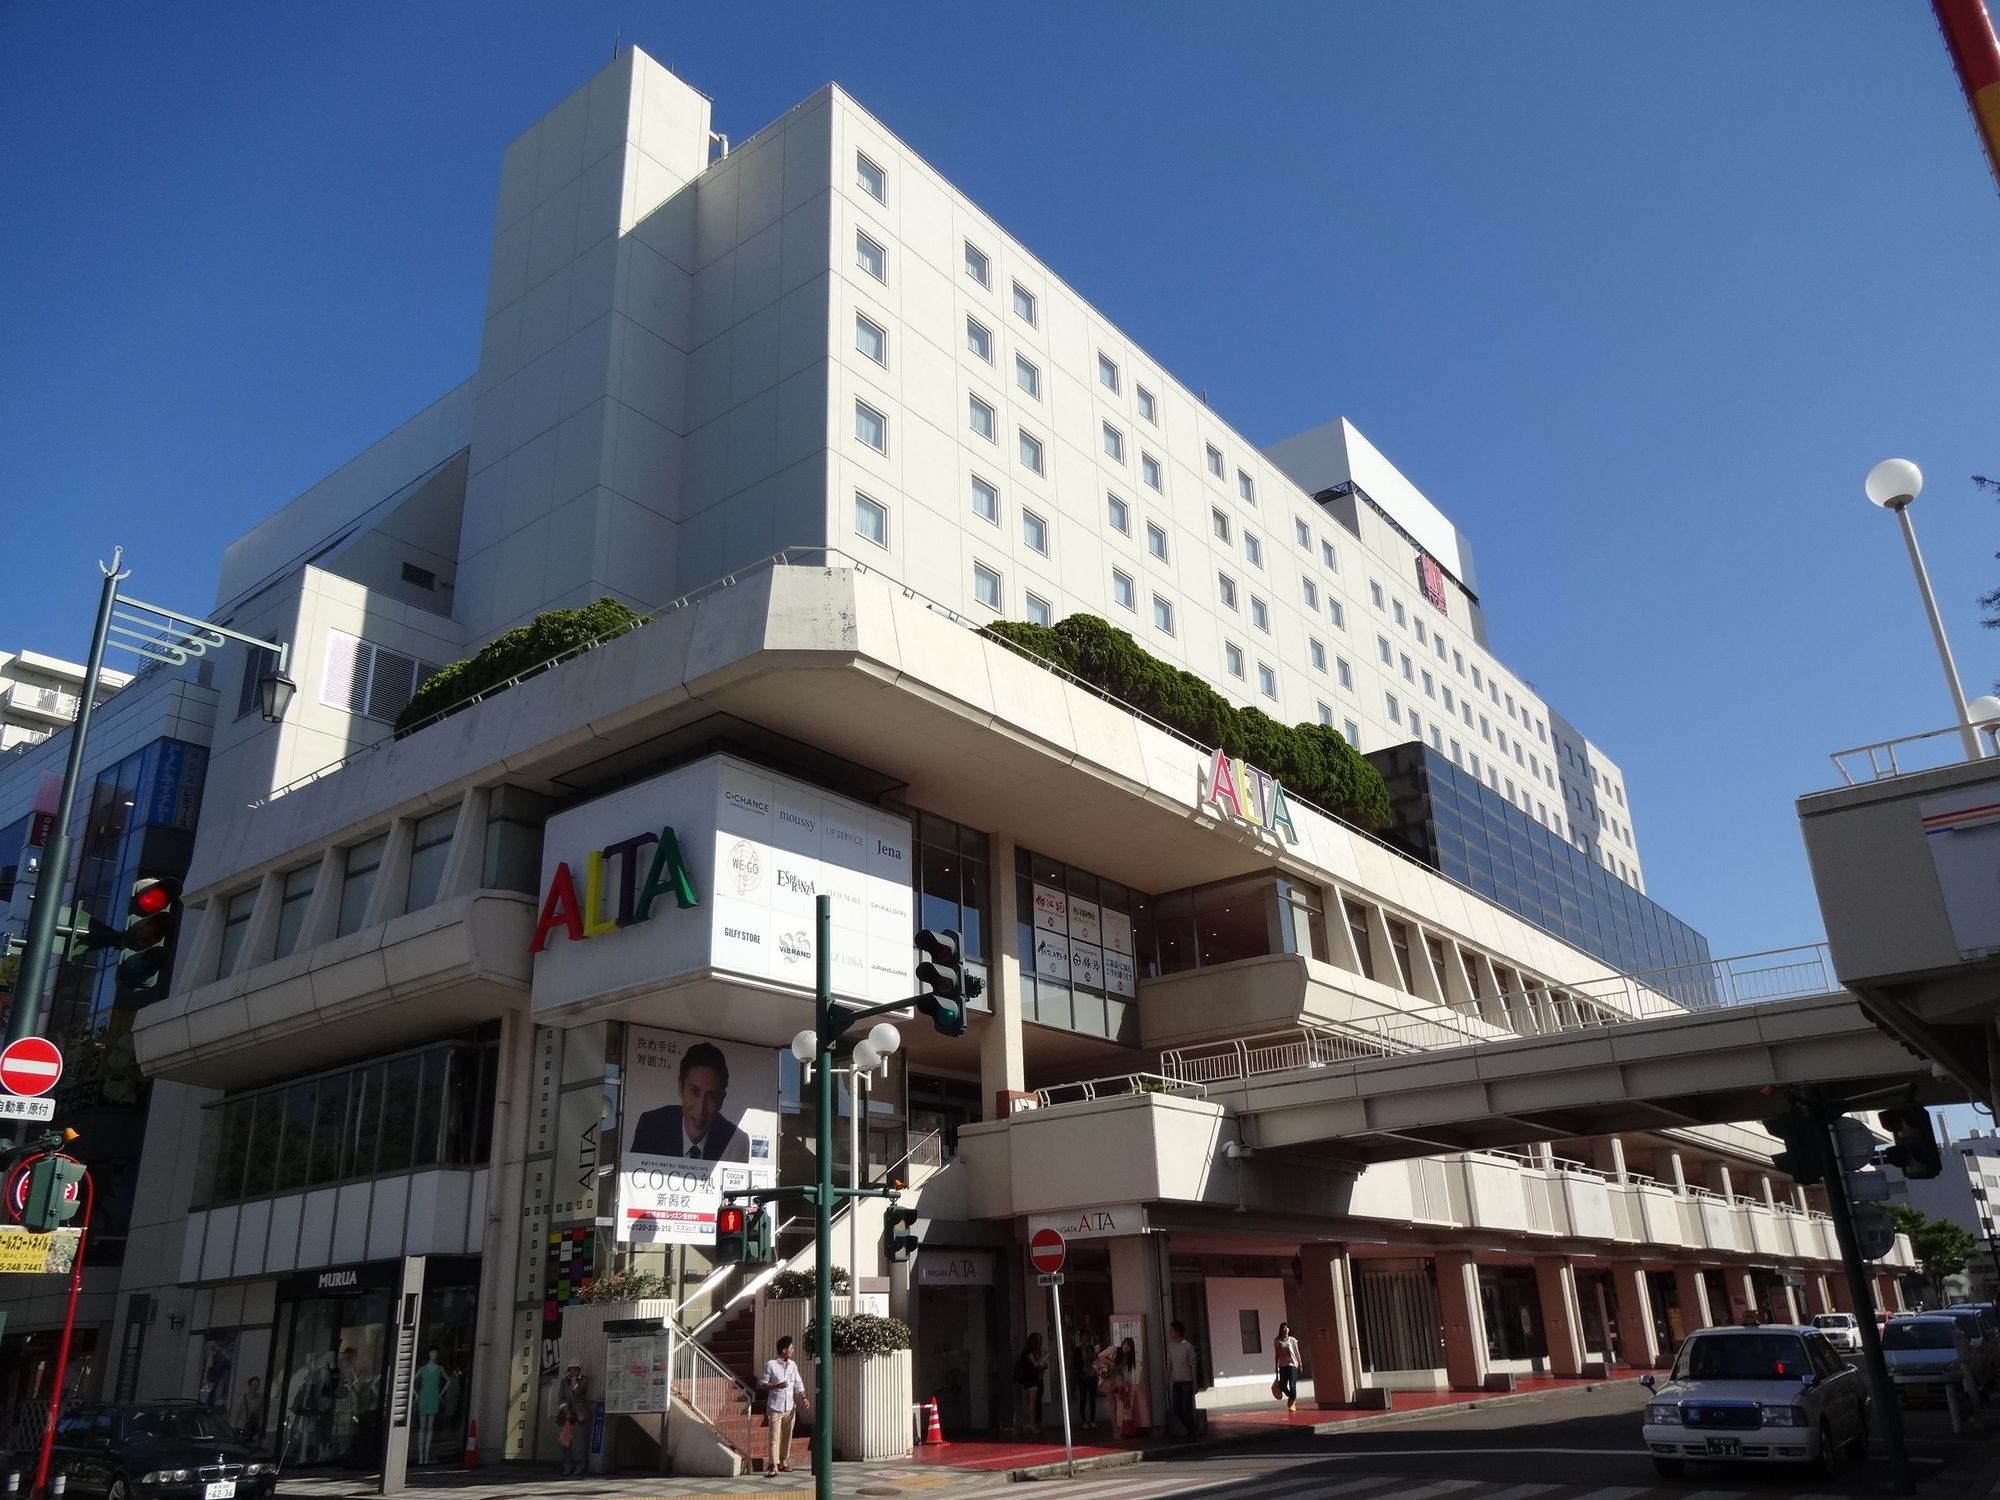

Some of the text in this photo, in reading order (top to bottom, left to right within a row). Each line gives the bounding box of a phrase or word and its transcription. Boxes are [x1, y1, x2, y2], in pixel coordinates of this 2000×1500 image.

[1205, 748, 1299, 845] ALTA
[779, 810, 815, 832] moussy
[877, 840, 901, 859] Jena
[528, 826, 699, 953] ALTA
[724, 927, 760, 944] GILFY STORE
[637, 1038, 681, 1055] 決め手は、
[636, 1054, 671, 1069] 対話力。
[579, 1121, 598, 1191] ALTA
[631, 1167, 715, 1195] COCO塾
[656, 1193, 691, 1209] 新潟校
[631, 1223, 671, 1232] 0120-339-212
[0, 1234, 48, 1251] ールズコートネイル
[948, 1259, 977, 1278] ATA
[318, 1270, 357, 1289] MURUA
